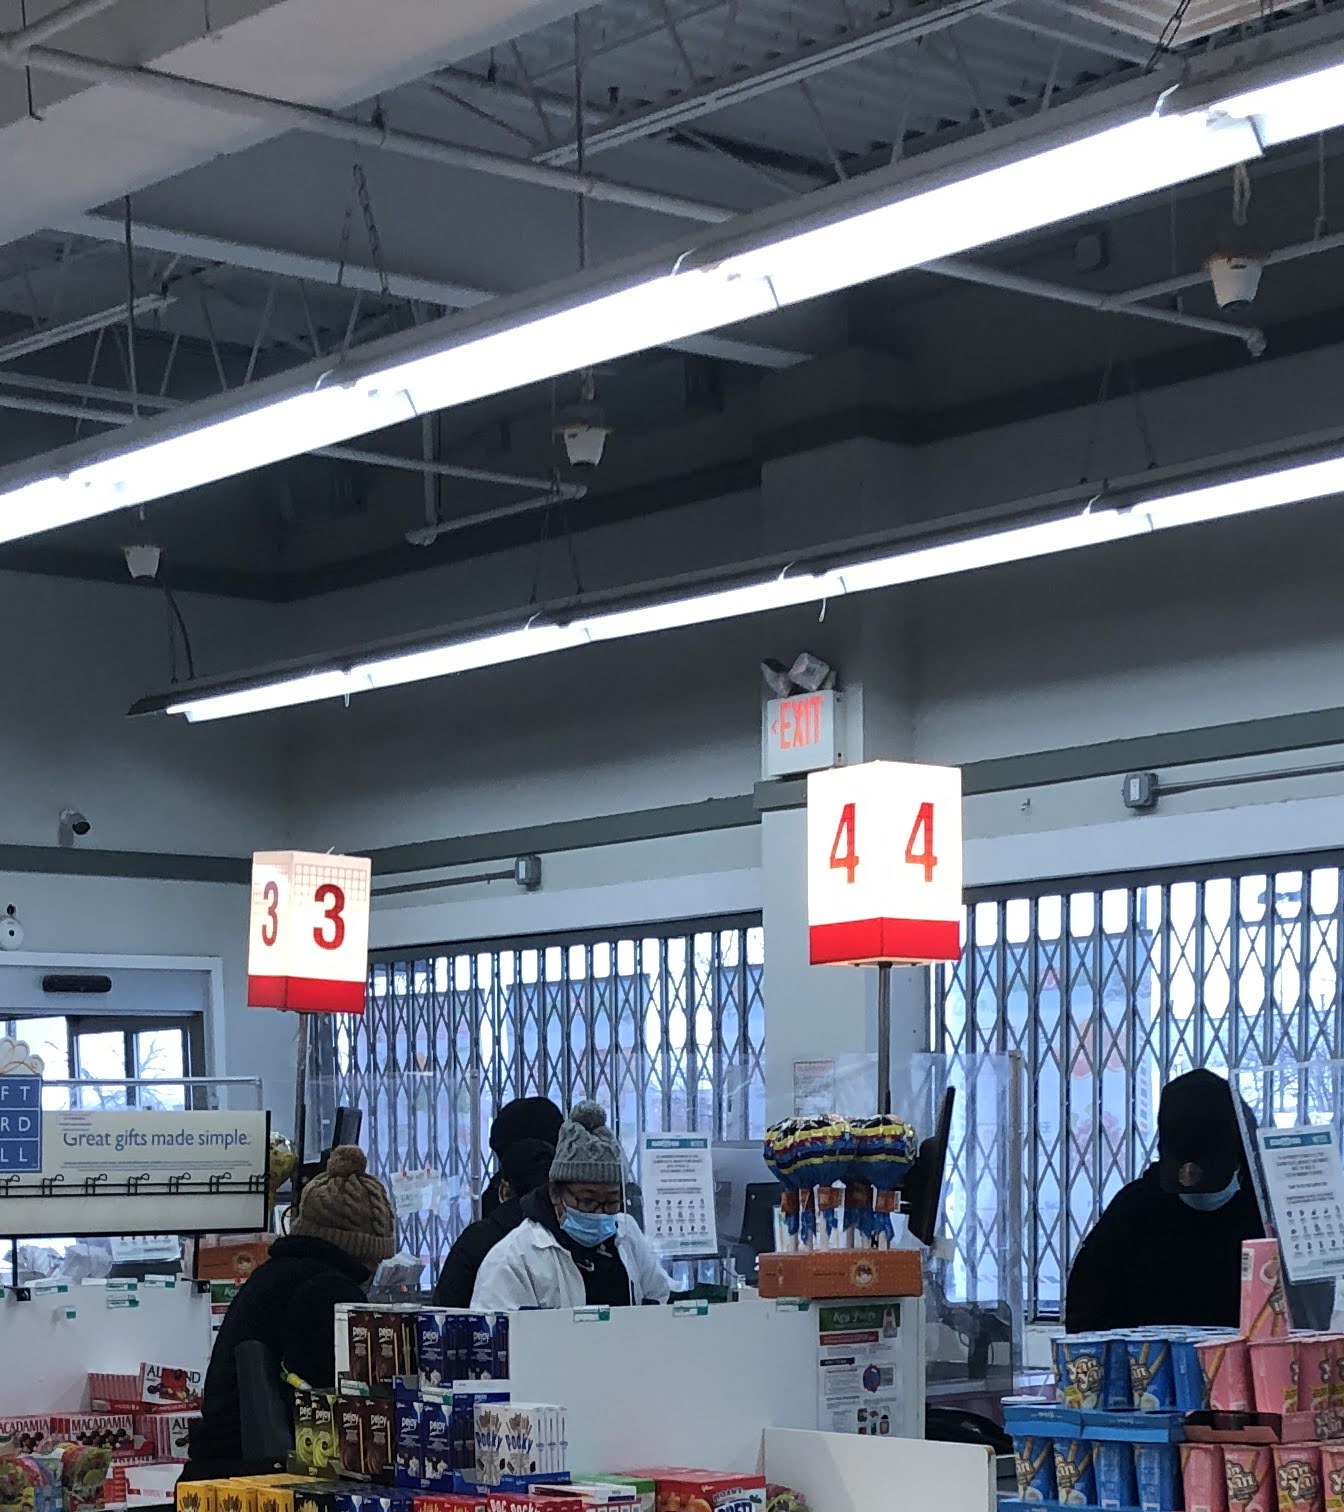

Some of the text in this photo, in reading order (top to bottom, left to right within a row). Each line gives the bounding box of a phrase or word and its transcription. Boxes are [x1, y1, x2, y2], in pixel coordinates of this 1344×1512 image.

[780, 695, 823, 749] EXIT
[830, 803, 859, 884] 4
[905, 802, 937, 882] 4
[262, 881, 279, 946] 3
[313, 884, 345, 950] 3
[63, 1132, 111, 1146] Great
[115, 1128, 147, 1151] gifts
[152, 1129, 193, 1145] made
[353, 1327, 368, 1339] pejoy
[379, 1327, 394, 1340] pejoy
[423, 1330, 438, 1343] pejoy
[473, 1331, 489, 1344] pejoy
[315, 1410, 332, 1421] pejoy
[343, 1413, 360, 1425] pejoy
[370, 1414, 388, 1427] pejoy
[72, 1415, 132, 1431] MACADAMIA
[401, 1417, 418, 1429] pejoy
[430, 1420, 445, 1433] pejoy
